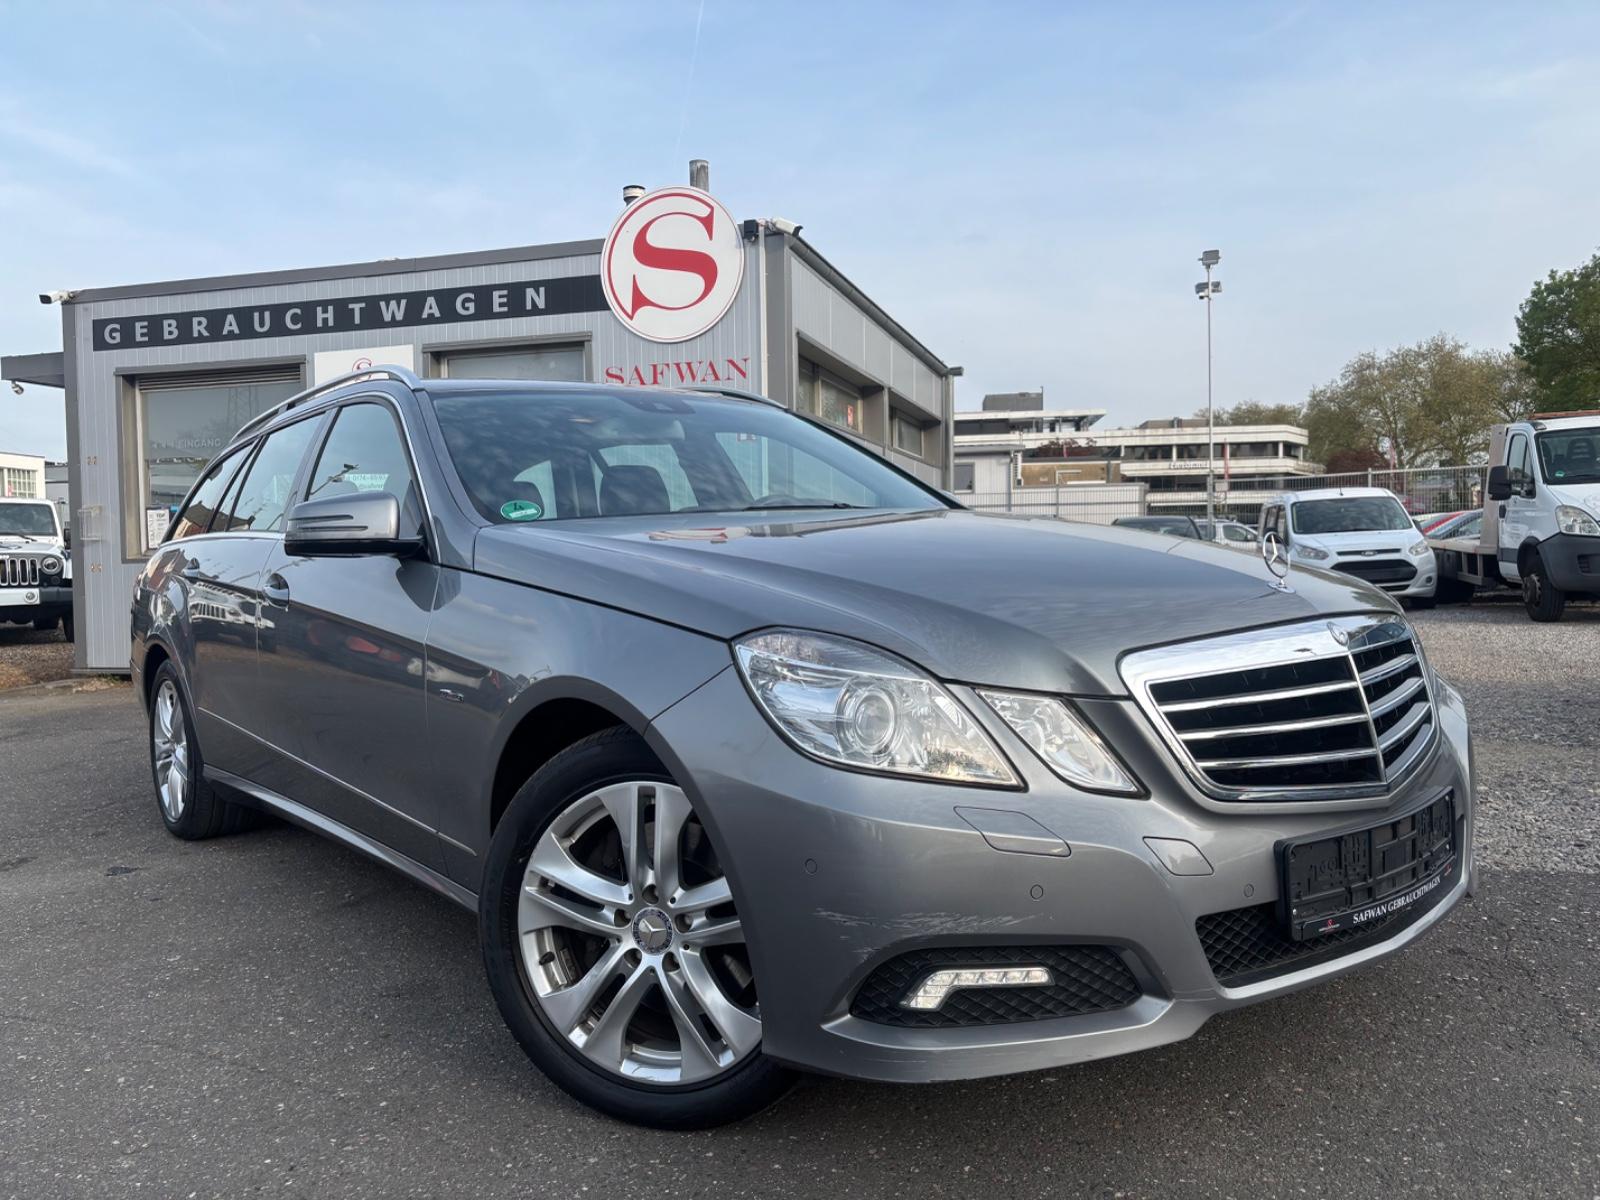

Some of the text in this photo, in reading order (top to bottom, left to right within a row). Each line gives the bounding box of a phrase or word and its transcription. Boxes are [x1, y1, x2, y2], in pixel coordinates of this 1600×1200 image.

[624, 202, 719, 321] S
[104, 286, 547, 344] GEBRAUCHTWAGEN
[605, 357, 750, 386] SAFWAN
[177, 438, 221, 449] EINGANG
[1353, 874, 1441, 924] SAFWAN GEBRAUCHTWAGEN
